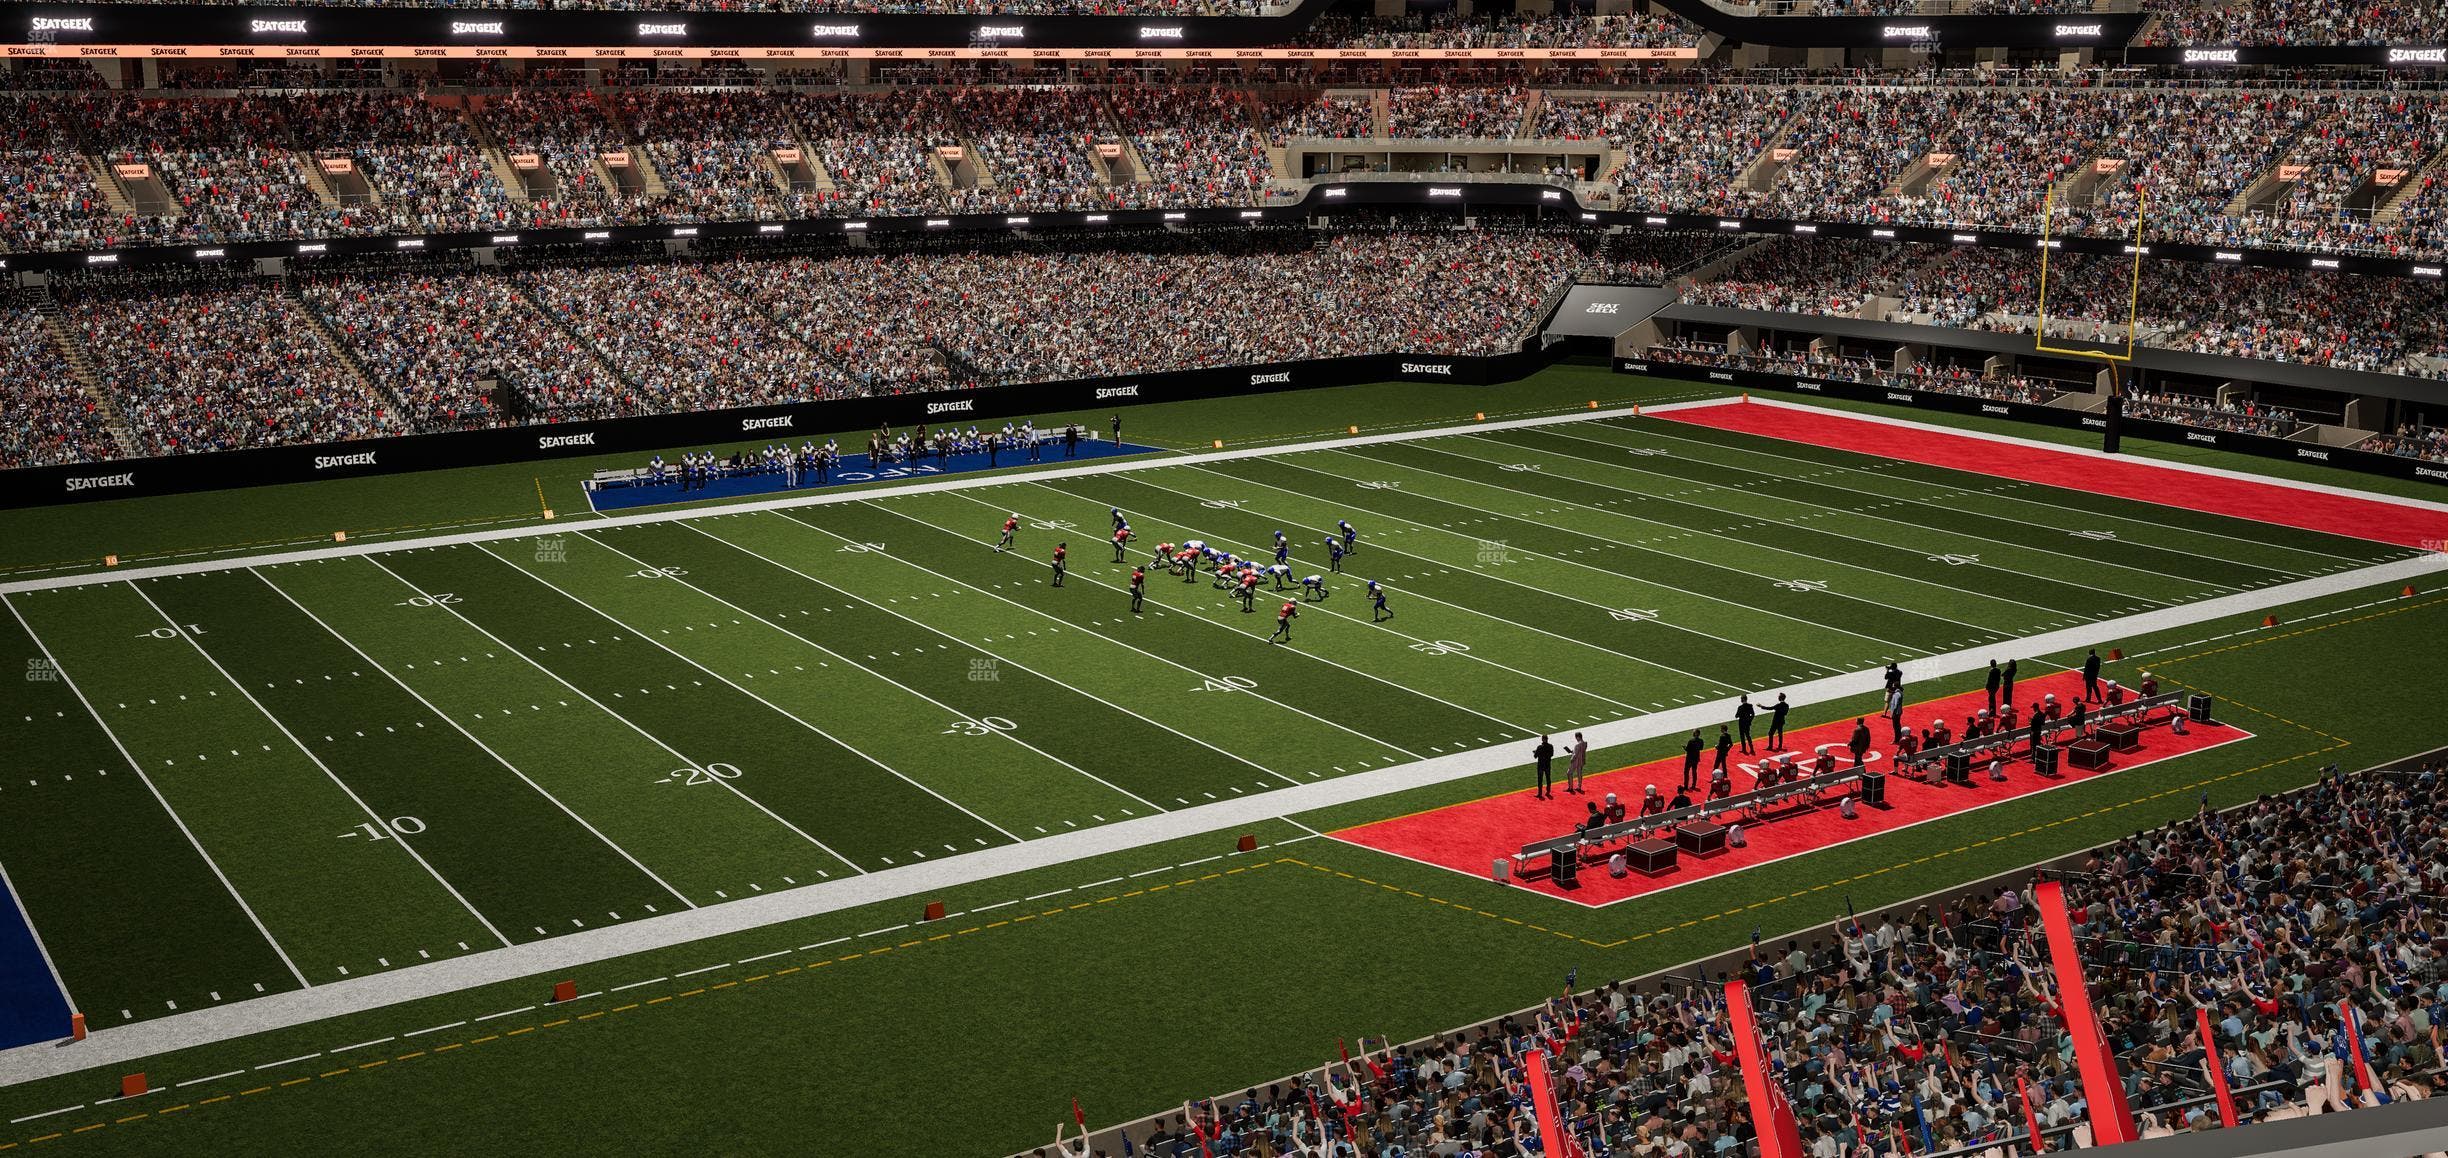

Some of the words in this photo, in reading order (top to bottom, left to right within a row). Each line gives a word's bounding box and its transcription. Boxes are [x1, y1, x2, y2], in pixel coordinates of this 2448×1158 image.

[32, 17, 93, 31] SEATGEEK
[252, 20, 307, 32] SEATGEEK
[452, 22, 503, 34] SEATGEEK
[639, 24, 686, 35] SEATGEEK
[814, 25, 859, 36] SEATGEEK
[2056, 25, 2101, 36] SEATGEEK
[981, 26, 1023, 37] SEATGEEK
[1141, 27, 1182, 38] SEATGEEK
[1884, 26, 1929, 37] SEATGEEK
[2184, 49, 2237, 62] SEATGEEK
[2389, 48, 2446, 62] SEATGEEK
[1402, 363, 1451, 375] SEATGEEK
[1251, 372, 1289, 385] SEATGEEK
[1096, 385, 1138, 399] SEATGEEK
[928, 400, 973, 414] SEATGEEK
[743, 415, 792, 430] SEATGEEK
[539, 433, 595, 448] SEATGEEK
[315, 451, 376, 469] SEATGEEK
[66, 473, 134, 491] SEATGEEK
[1408, 640, 1470, 656] 50
